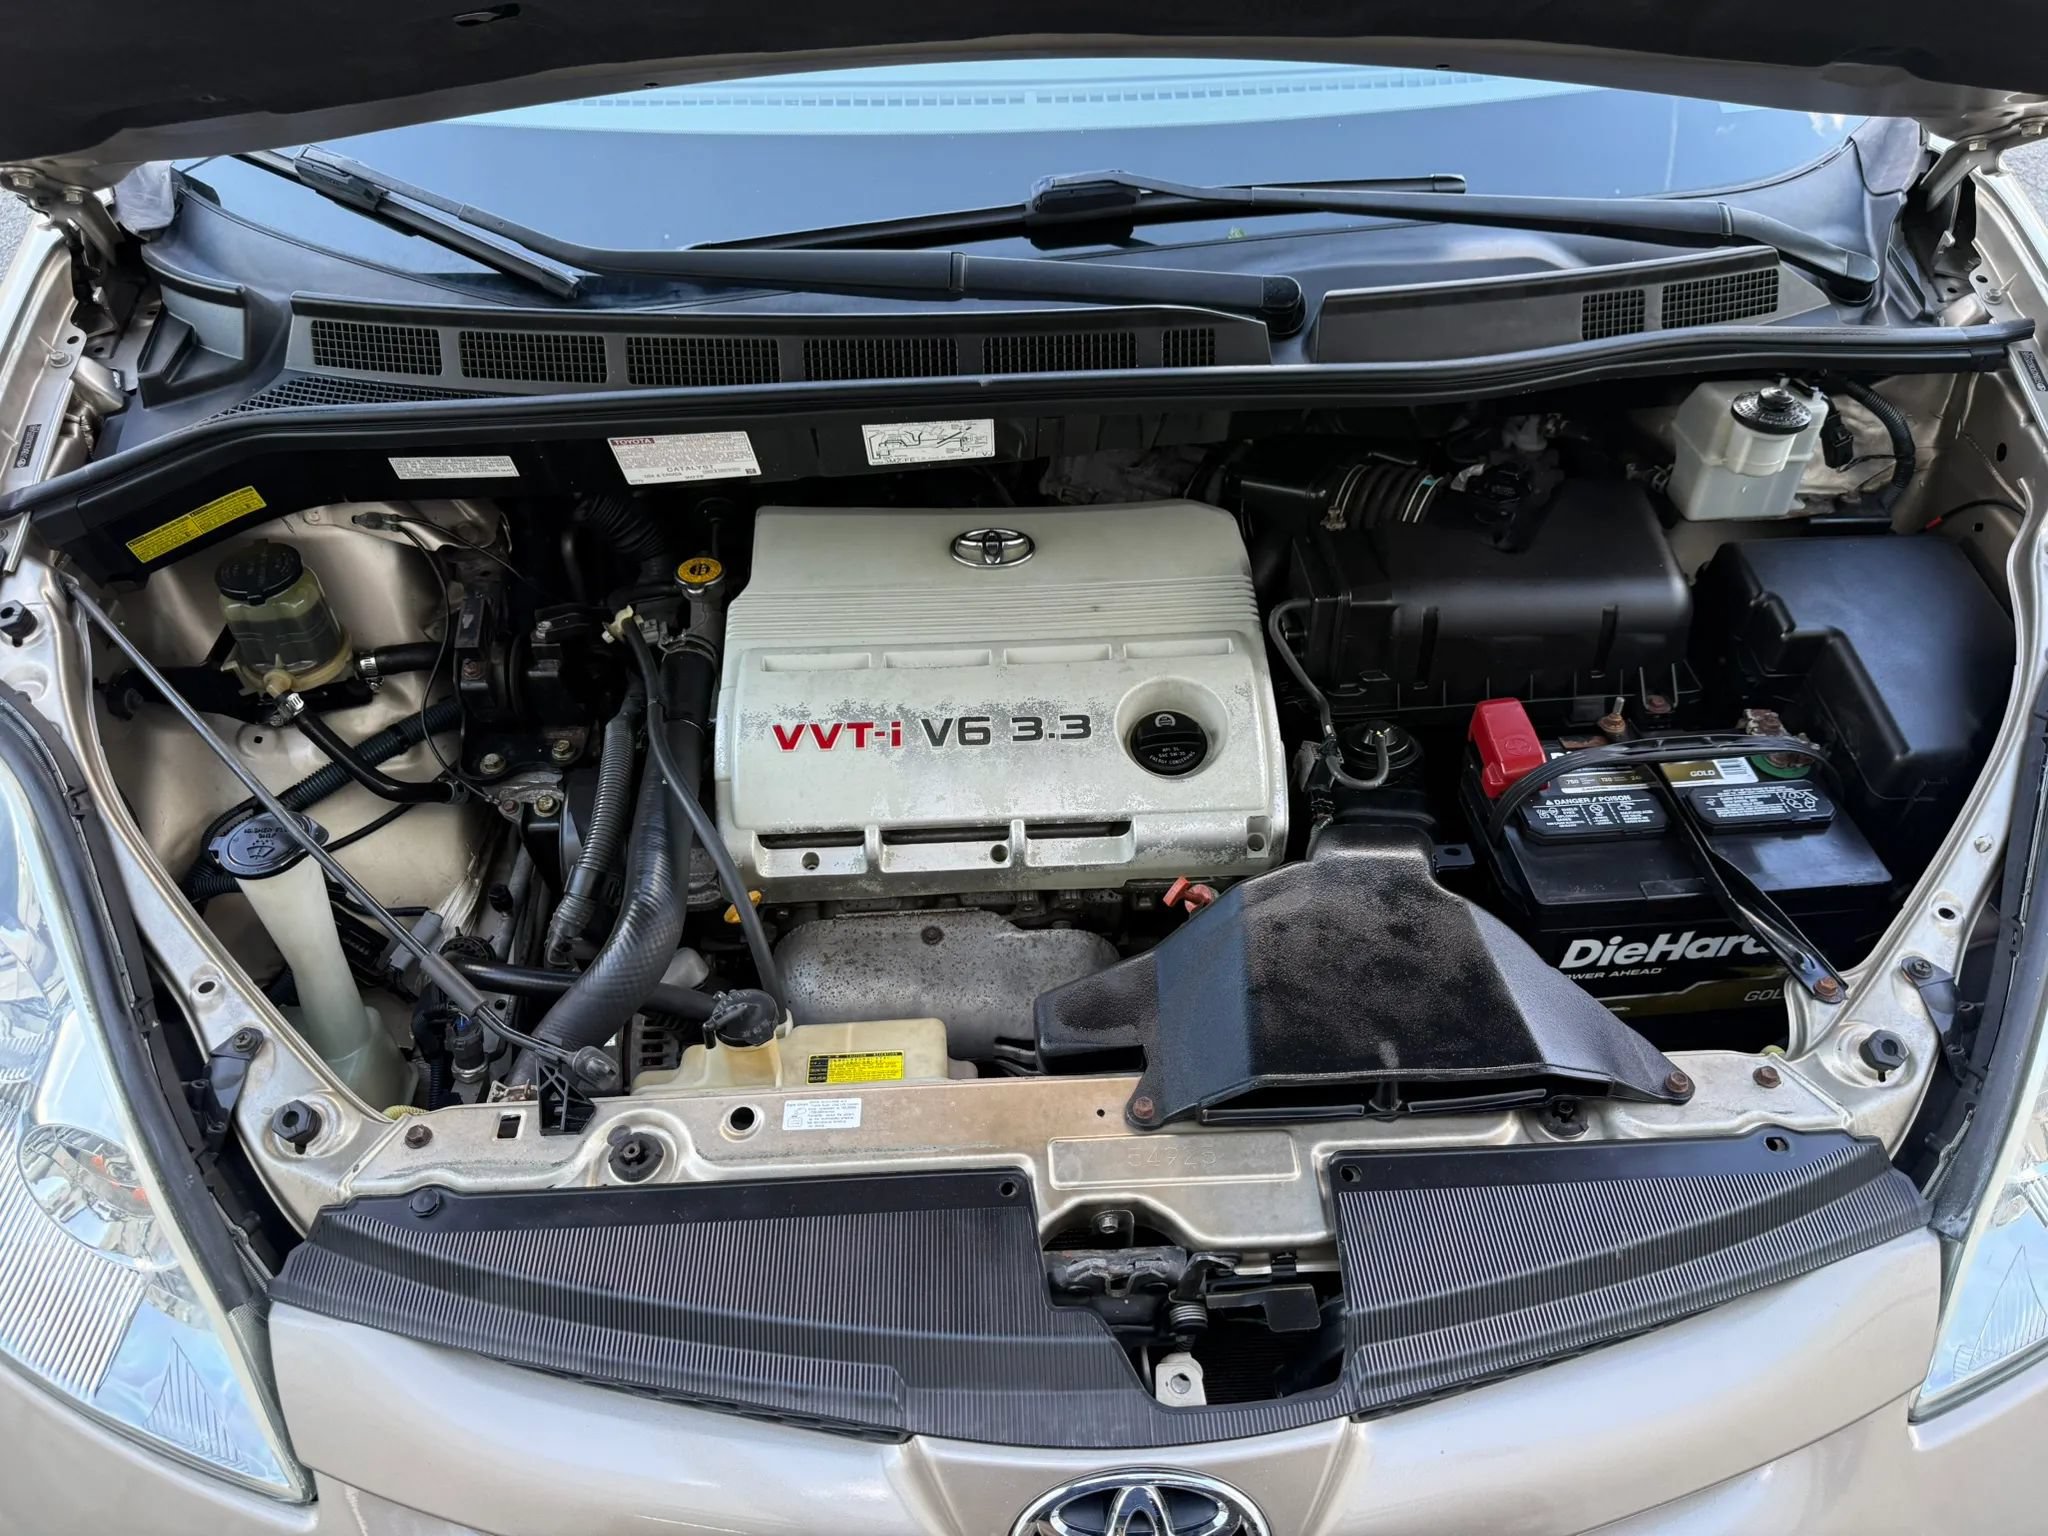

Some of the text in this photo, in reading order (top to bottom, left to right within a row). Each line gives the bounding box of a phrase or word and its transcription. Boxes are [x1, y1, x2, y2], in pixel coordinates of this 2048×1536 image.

[613, 438, 652, 446] TOYOTA
[666, 464, 714, 472] CATALYST
[772, 714, 1093, 752] VVT-i V6 3.3
[1689, 769, 1716, 777] GOLD
[1553, 797, 1590, 805] DANGER
[1598, 794, 1632, 803] POISON
[1608, 967, 1663, 978] AHEAD
[1743, 988, 1785, 1002] GOL
